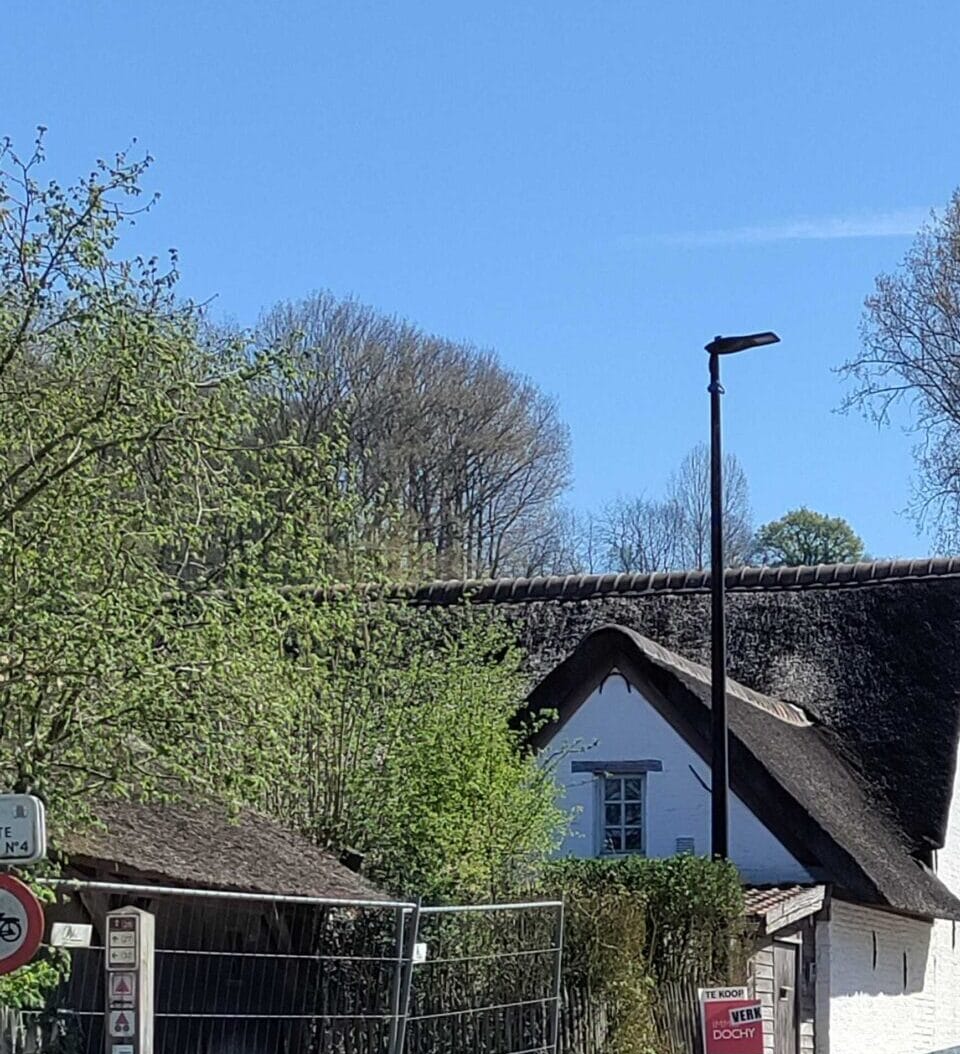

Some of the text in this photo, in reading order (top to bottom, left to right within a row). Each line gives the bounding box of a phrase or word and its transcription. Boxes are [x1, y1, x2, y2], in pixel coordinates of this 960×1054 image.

[705, 989, 744, 999] TE KOOP
[731, 1007, 762, 1022] VERK
[713, 1028, 756, 1040] DOCHY
